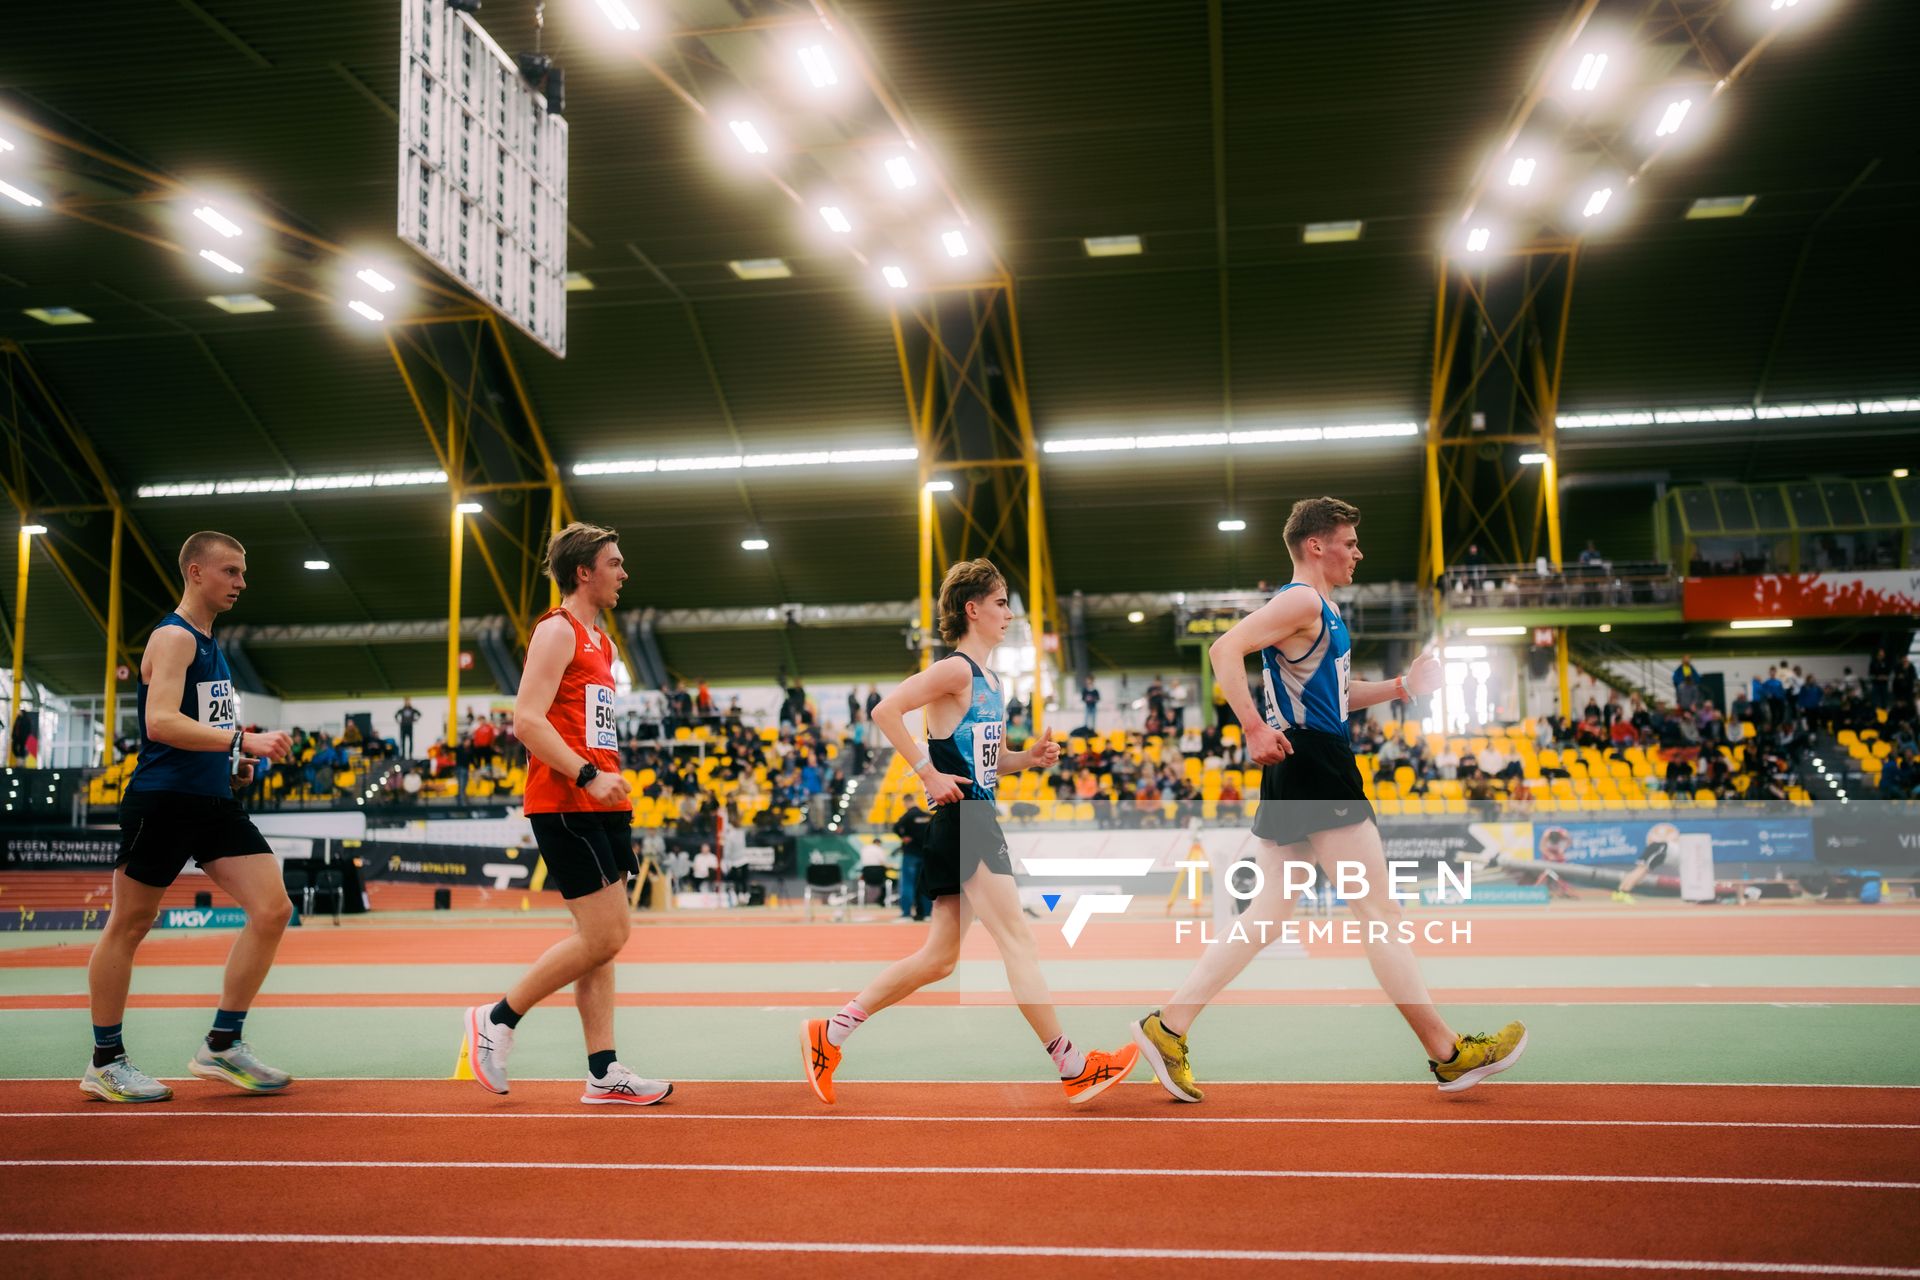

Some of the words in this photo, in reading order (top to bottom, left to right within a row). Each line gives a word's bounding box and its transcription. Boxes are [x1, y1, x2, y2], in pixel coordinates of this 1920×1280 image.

[211, 683, 229, 697] GLS
[209, 699, 233, 722] 249
[8, 841, 48, 851] GEGEN
[169, 910, 213, 928] WGV
